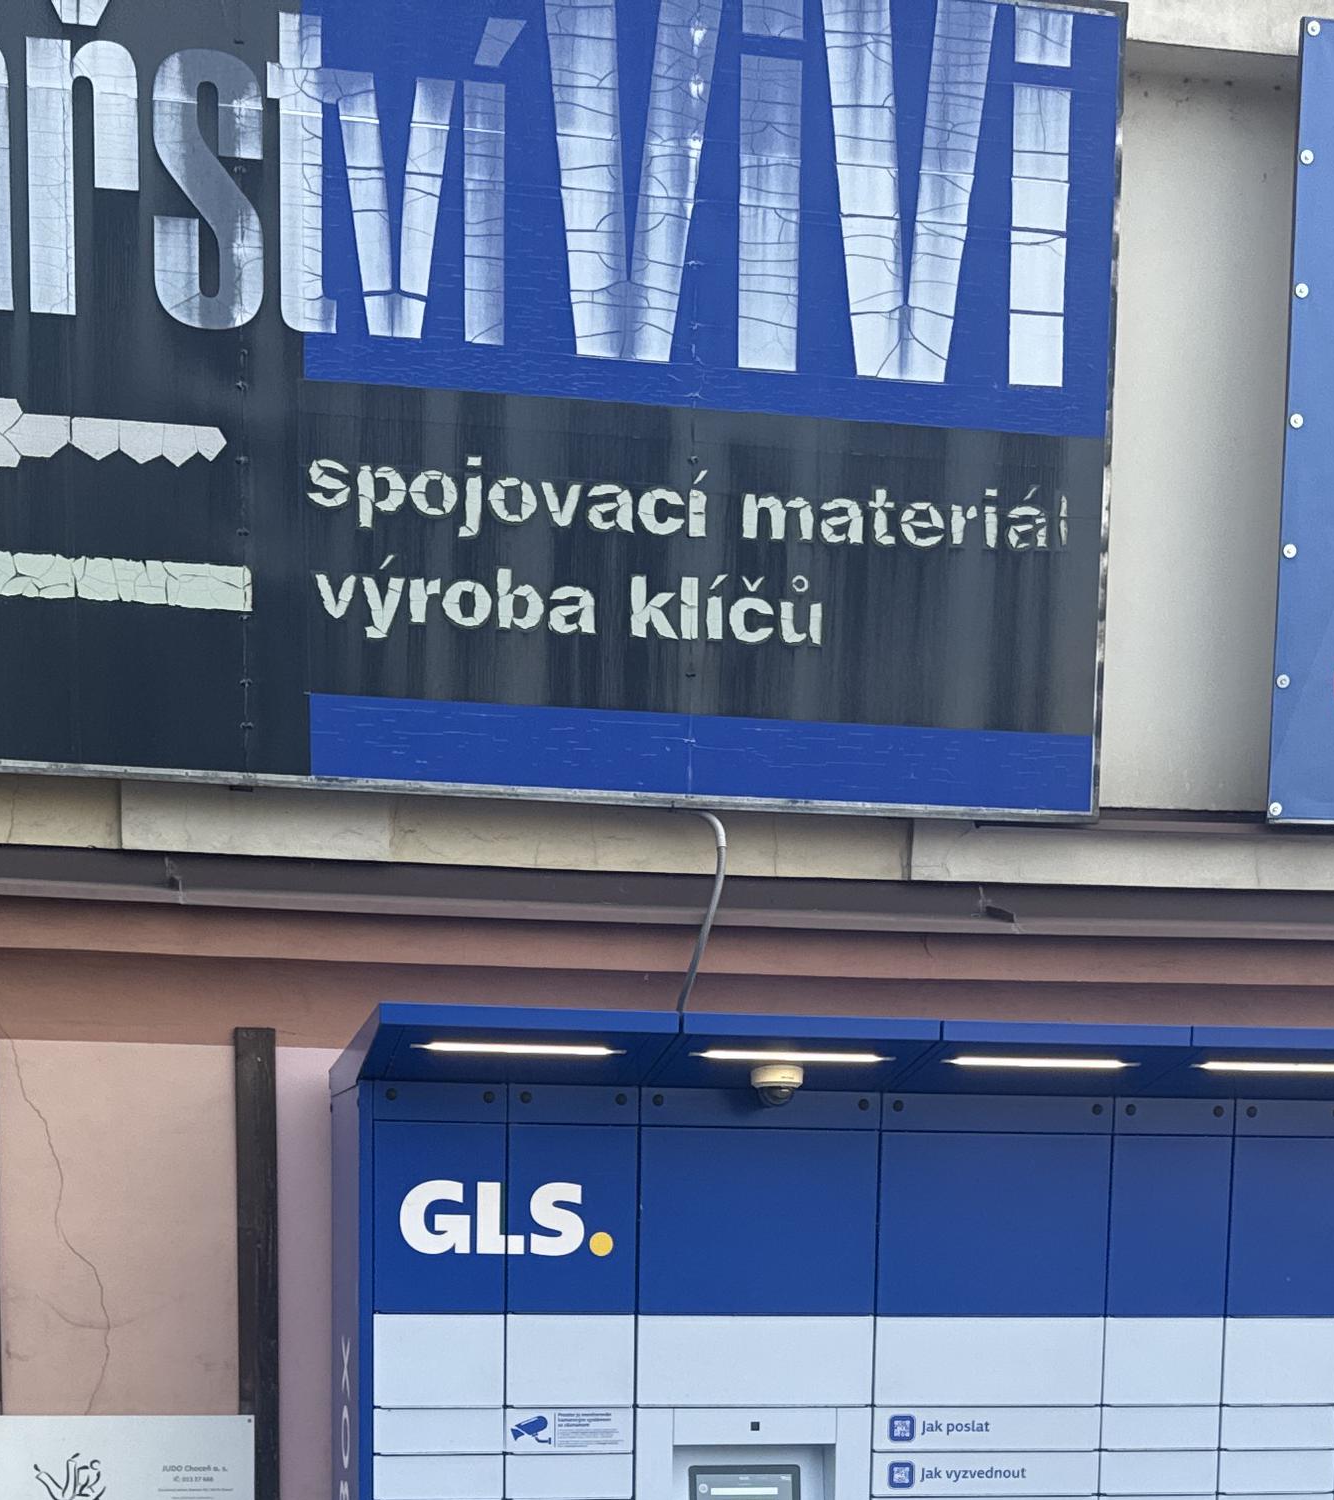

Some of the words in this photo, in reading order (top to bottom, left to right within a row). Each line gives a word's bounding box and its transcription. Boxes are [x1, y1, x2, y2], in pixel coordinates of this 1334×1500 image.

[545, 0, 1074, 388] ViVi
[306, 455, 708, 539] spojovací
[314, 554, 597, 640] výroba
[628, 574, 825, 647] klíčů
[921, 1419, 942, 1434] Jak
[946, 1419, 991, 1435] poslat
[920, 1466, 942, 1482] Jak
[946, 1466, 1027, 1482] vyzvednout
